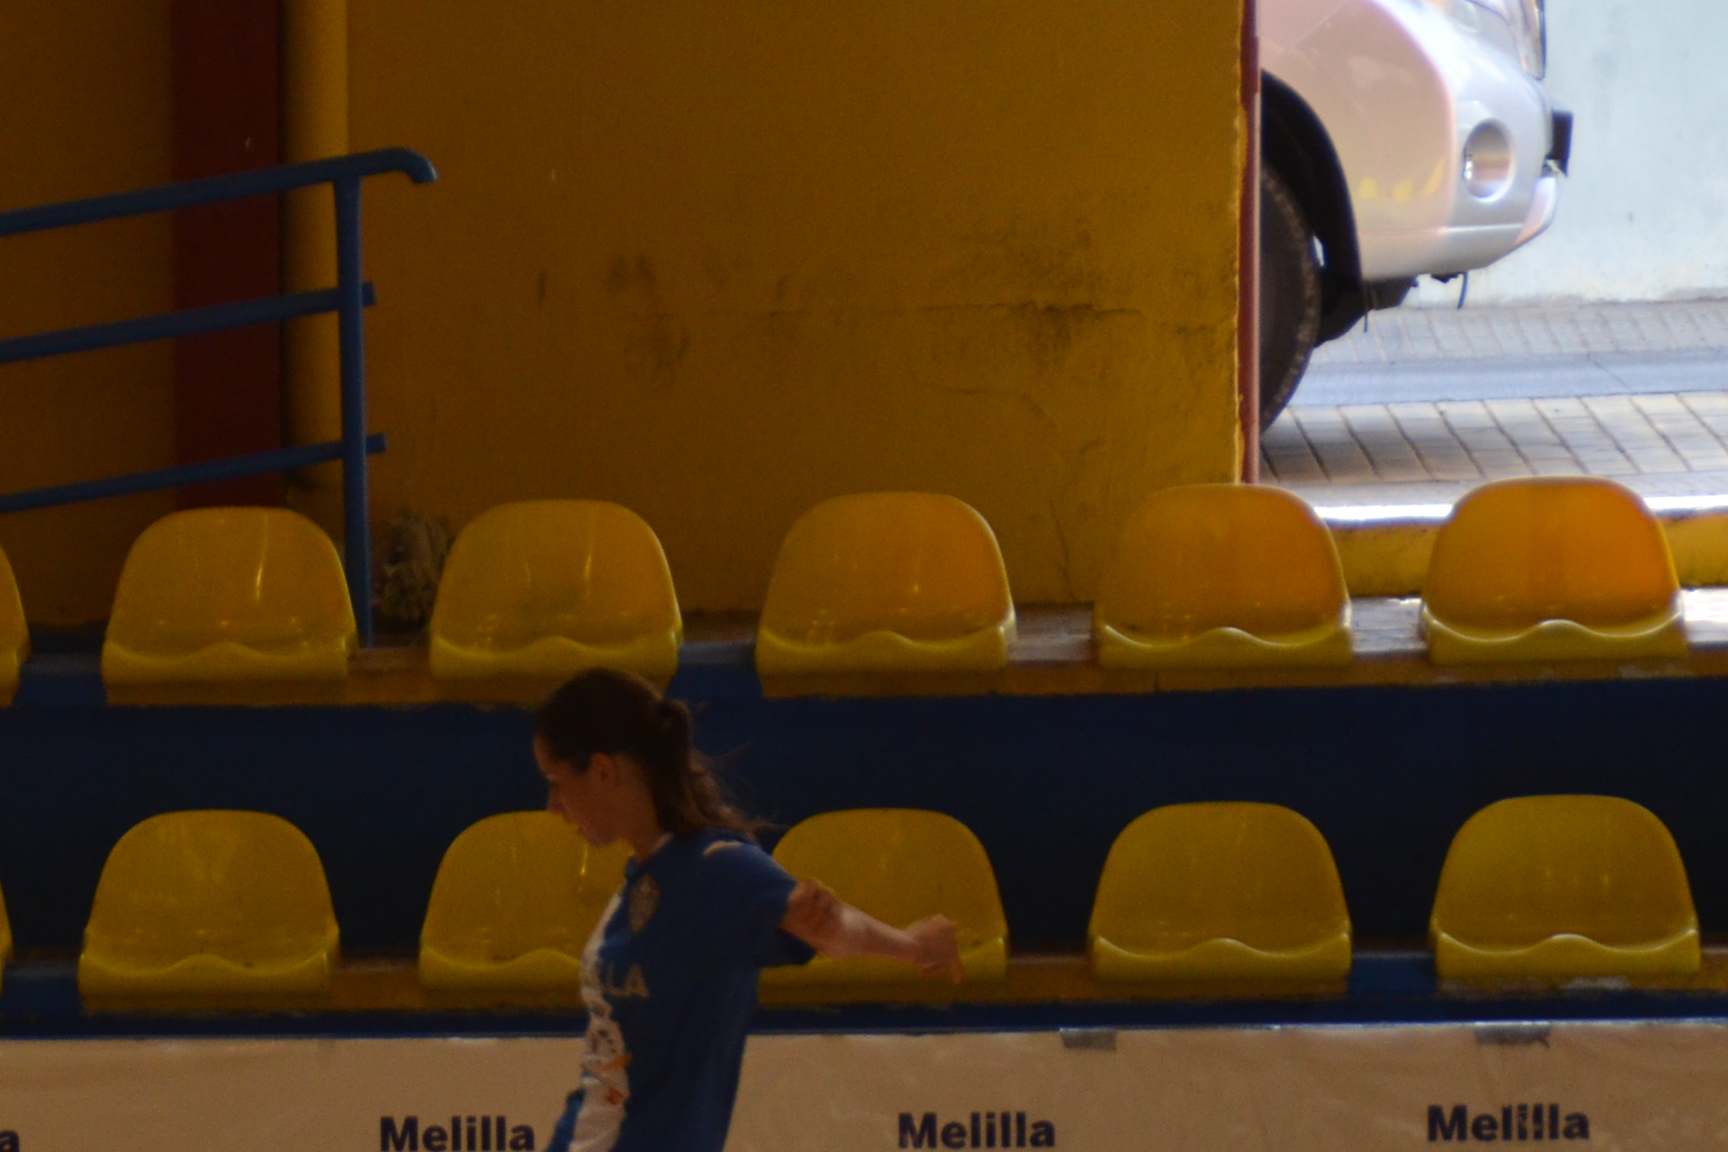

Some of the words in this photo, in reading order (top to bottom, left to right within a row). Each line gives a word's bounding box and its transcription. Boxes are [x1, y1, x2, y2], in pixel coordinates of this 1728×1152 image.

[379, 1116, 536, 1152] Melilla
[898, 1112, 1056, 1149] Melilla
[1426, 1104, 1591, 1142] Melilla
